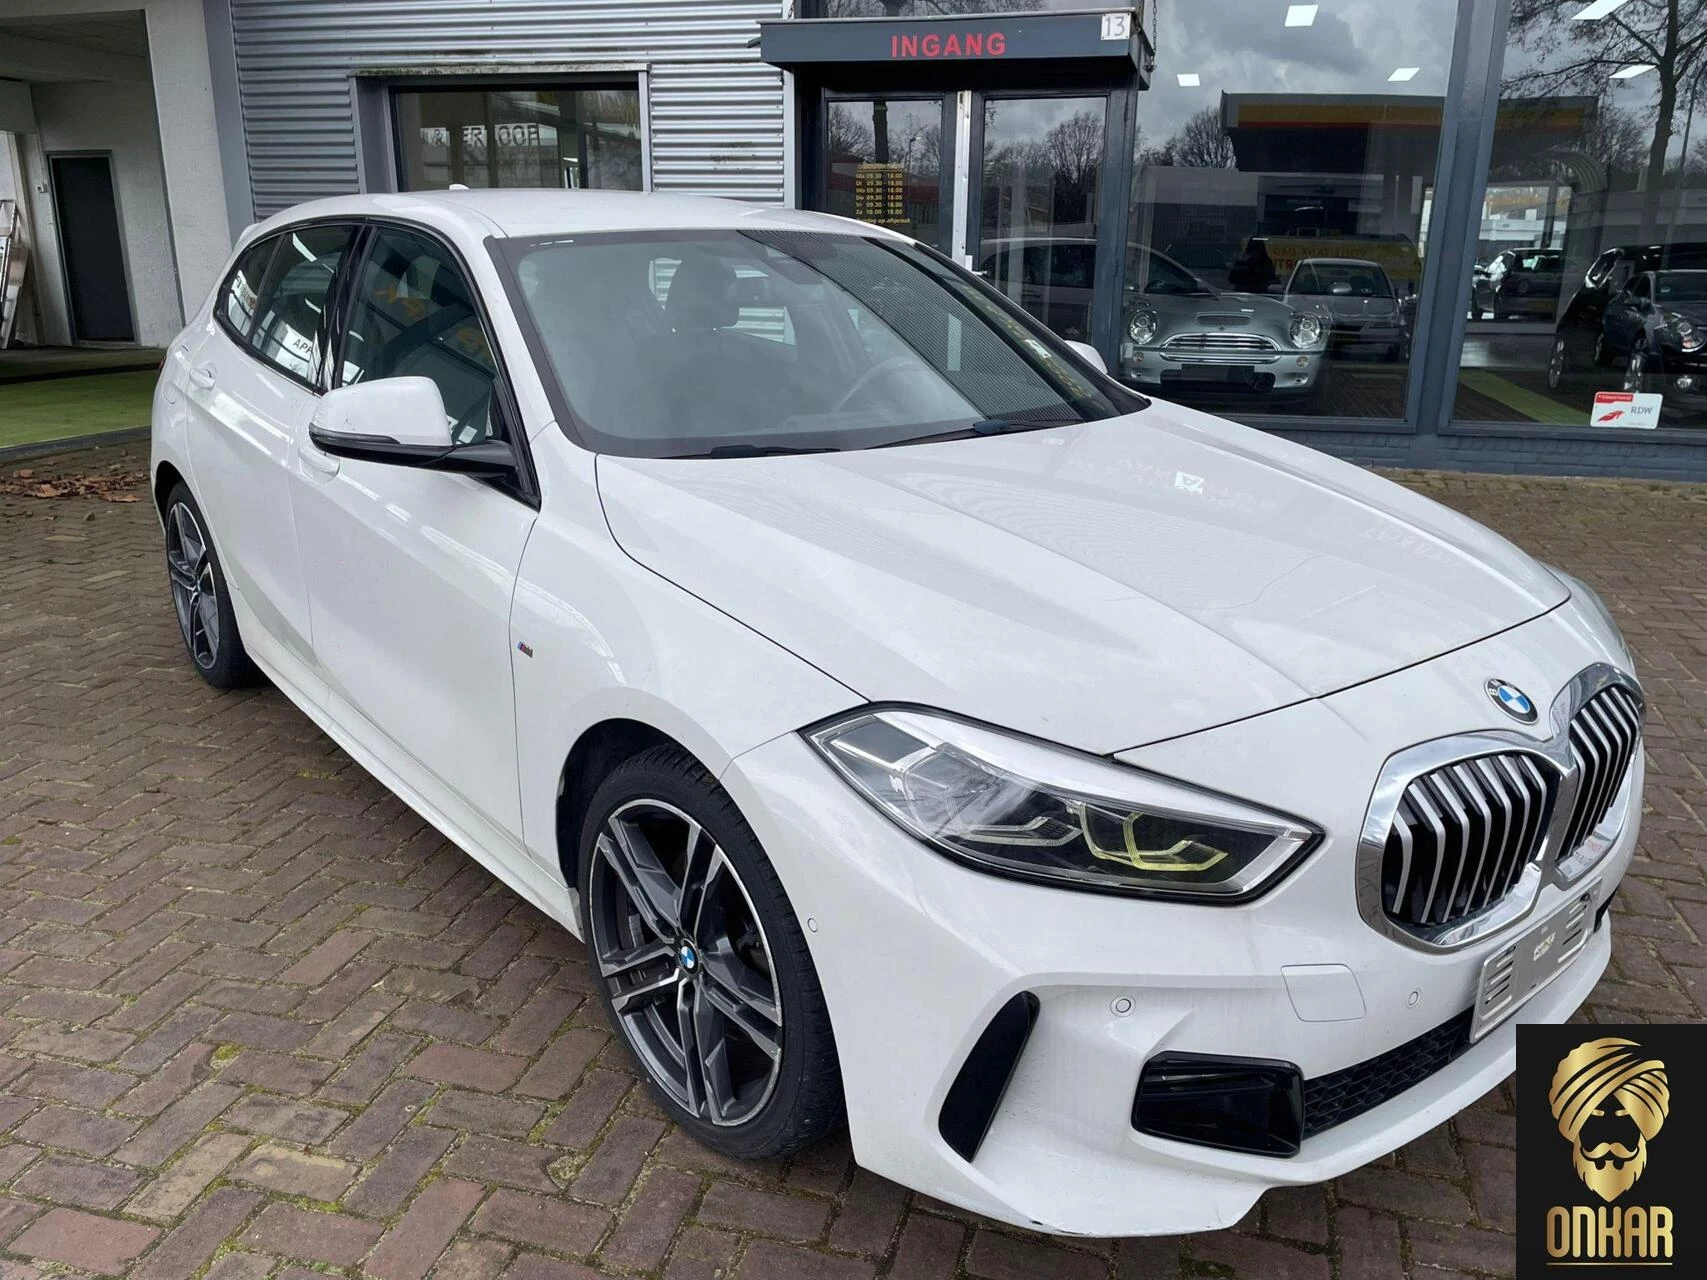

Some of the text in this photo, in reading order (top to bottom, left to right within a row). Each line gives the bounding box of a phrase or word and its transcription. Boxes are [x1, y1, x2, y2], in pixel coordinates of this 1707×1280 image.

[1105, 16, 1125, 37] 13
[890, 31, 1007, 58] INGANG
[1630, 406, 1654, 415] RDW
